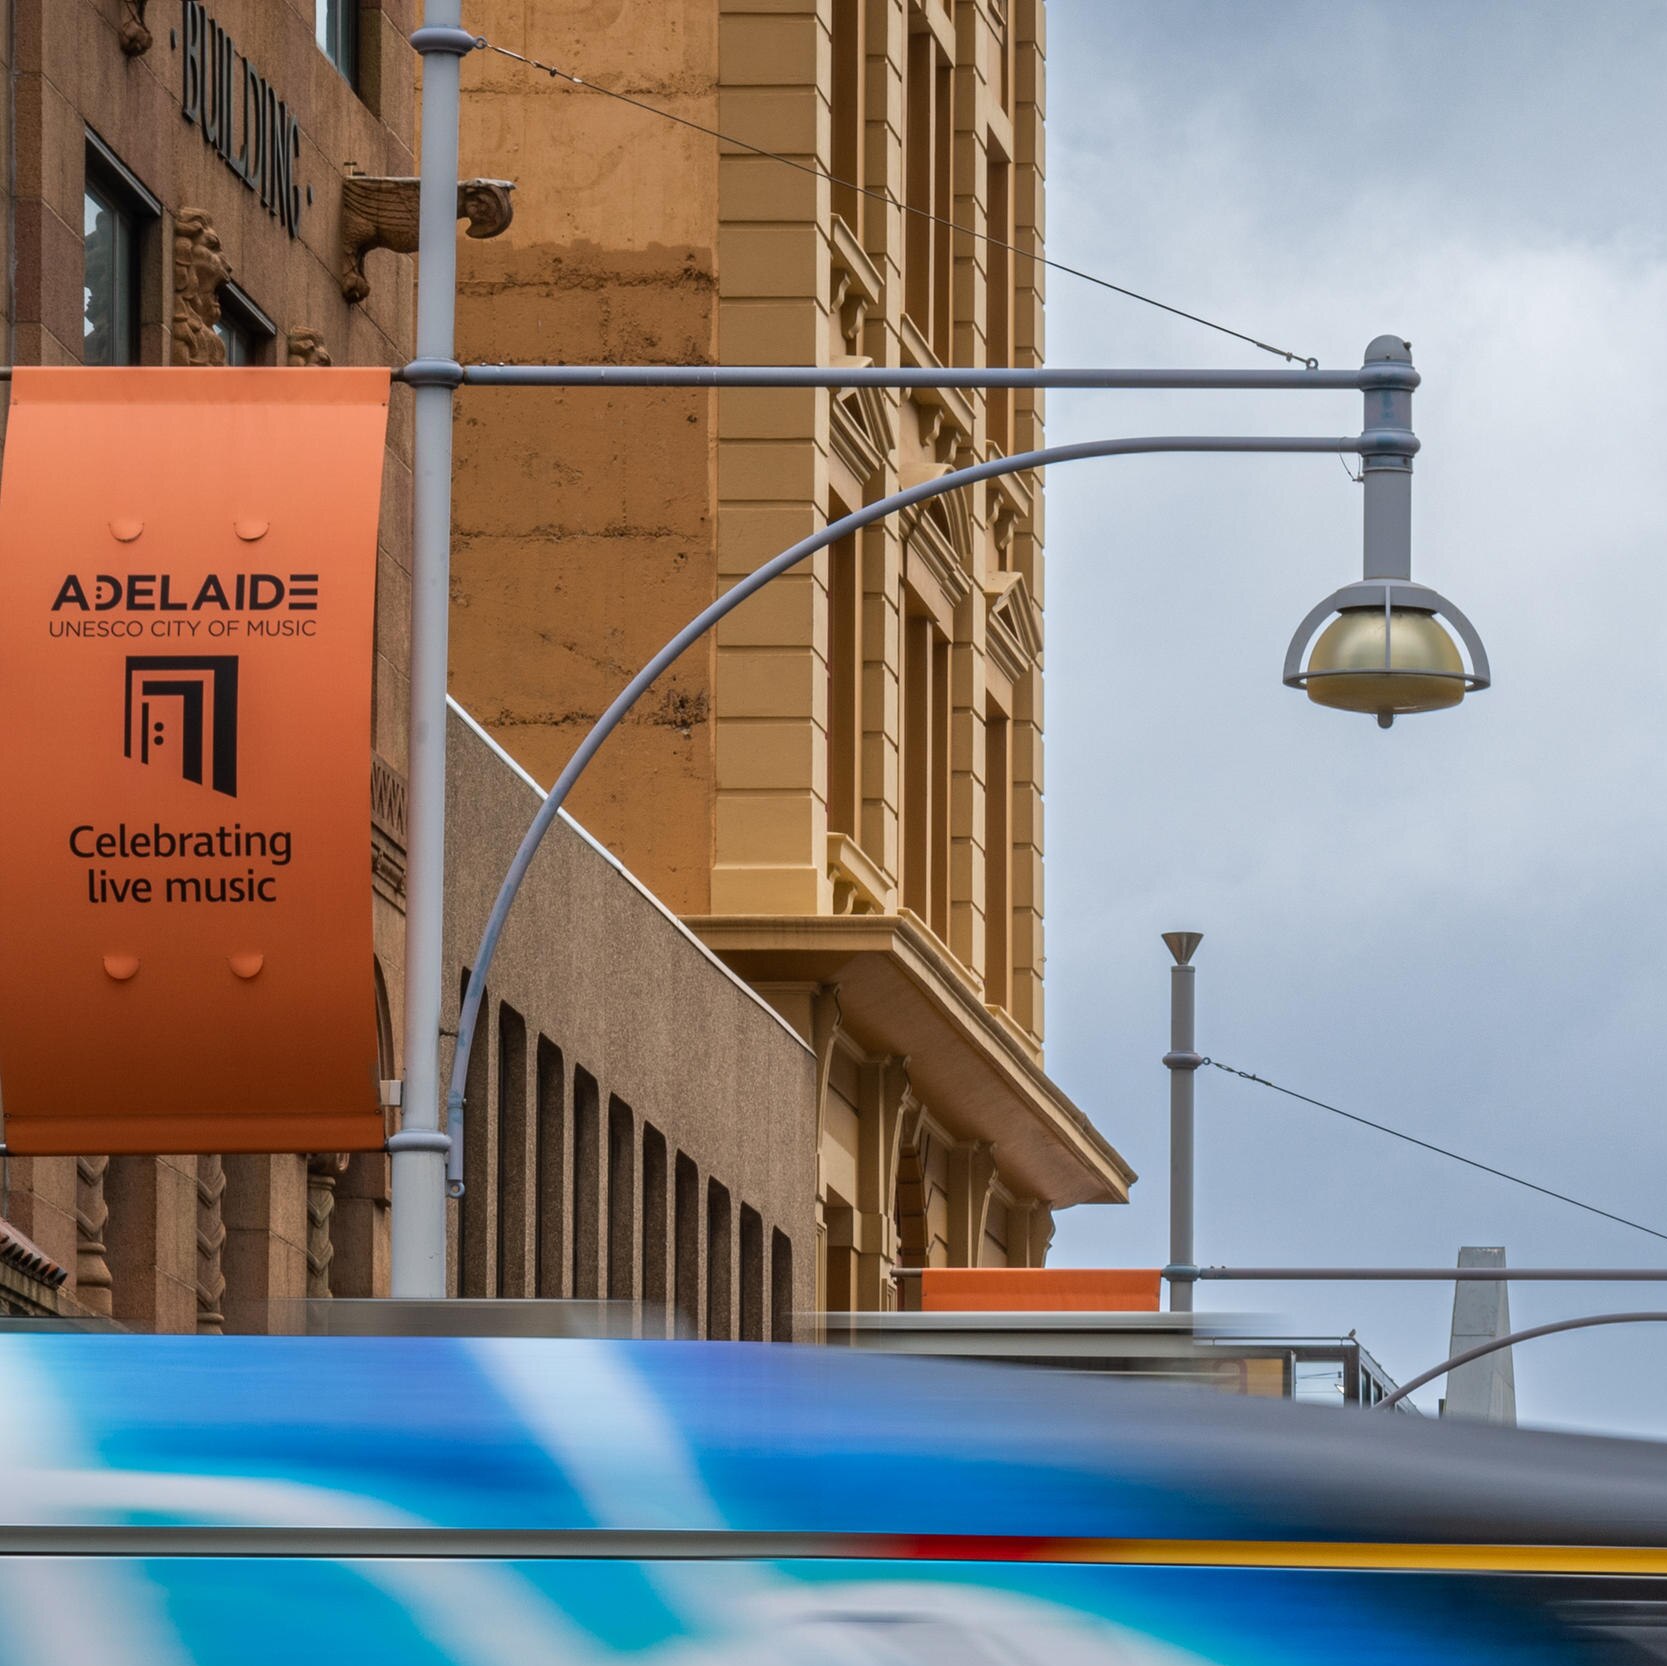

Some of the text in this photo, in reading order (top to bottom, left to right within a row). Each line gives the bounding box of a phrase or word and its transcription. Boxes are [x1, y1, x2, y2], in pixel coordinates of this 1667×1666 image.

[182, 1, 301, 239] BUILDING
[51, 574, 318, 612] ADELAIDE
[49, 620, 317, 638] UNESCO CITY OF MUSIC
[69, 824, 293, 866] Celebrating
[88, 869, 277, 904] live music
